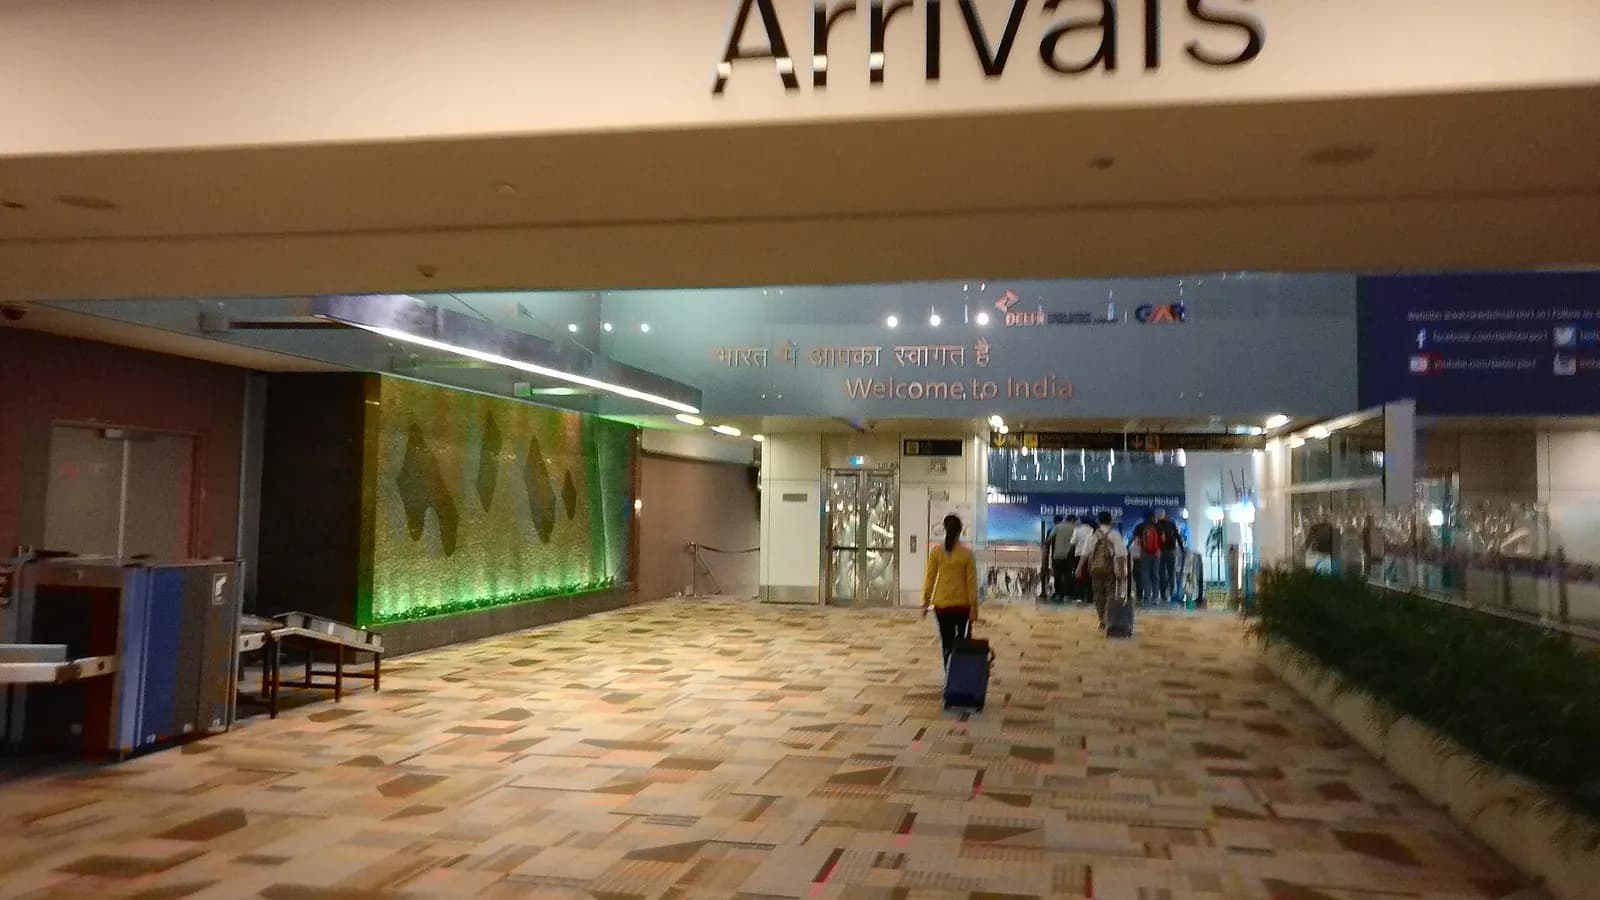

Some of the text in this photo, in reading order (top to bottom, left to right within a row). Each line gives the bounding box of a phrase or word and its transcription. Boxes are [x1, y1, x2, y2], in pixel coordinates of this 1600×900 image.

[713, 346, 769, 369] भारत
[807, 345, 881, 369] आपका
[894, 344, 967, 369] स्वागत
[974, 336, 992, 369] है
[846, 375, 1075, 400] Welcome to India
[1040, 504, 1054, 516] Do
